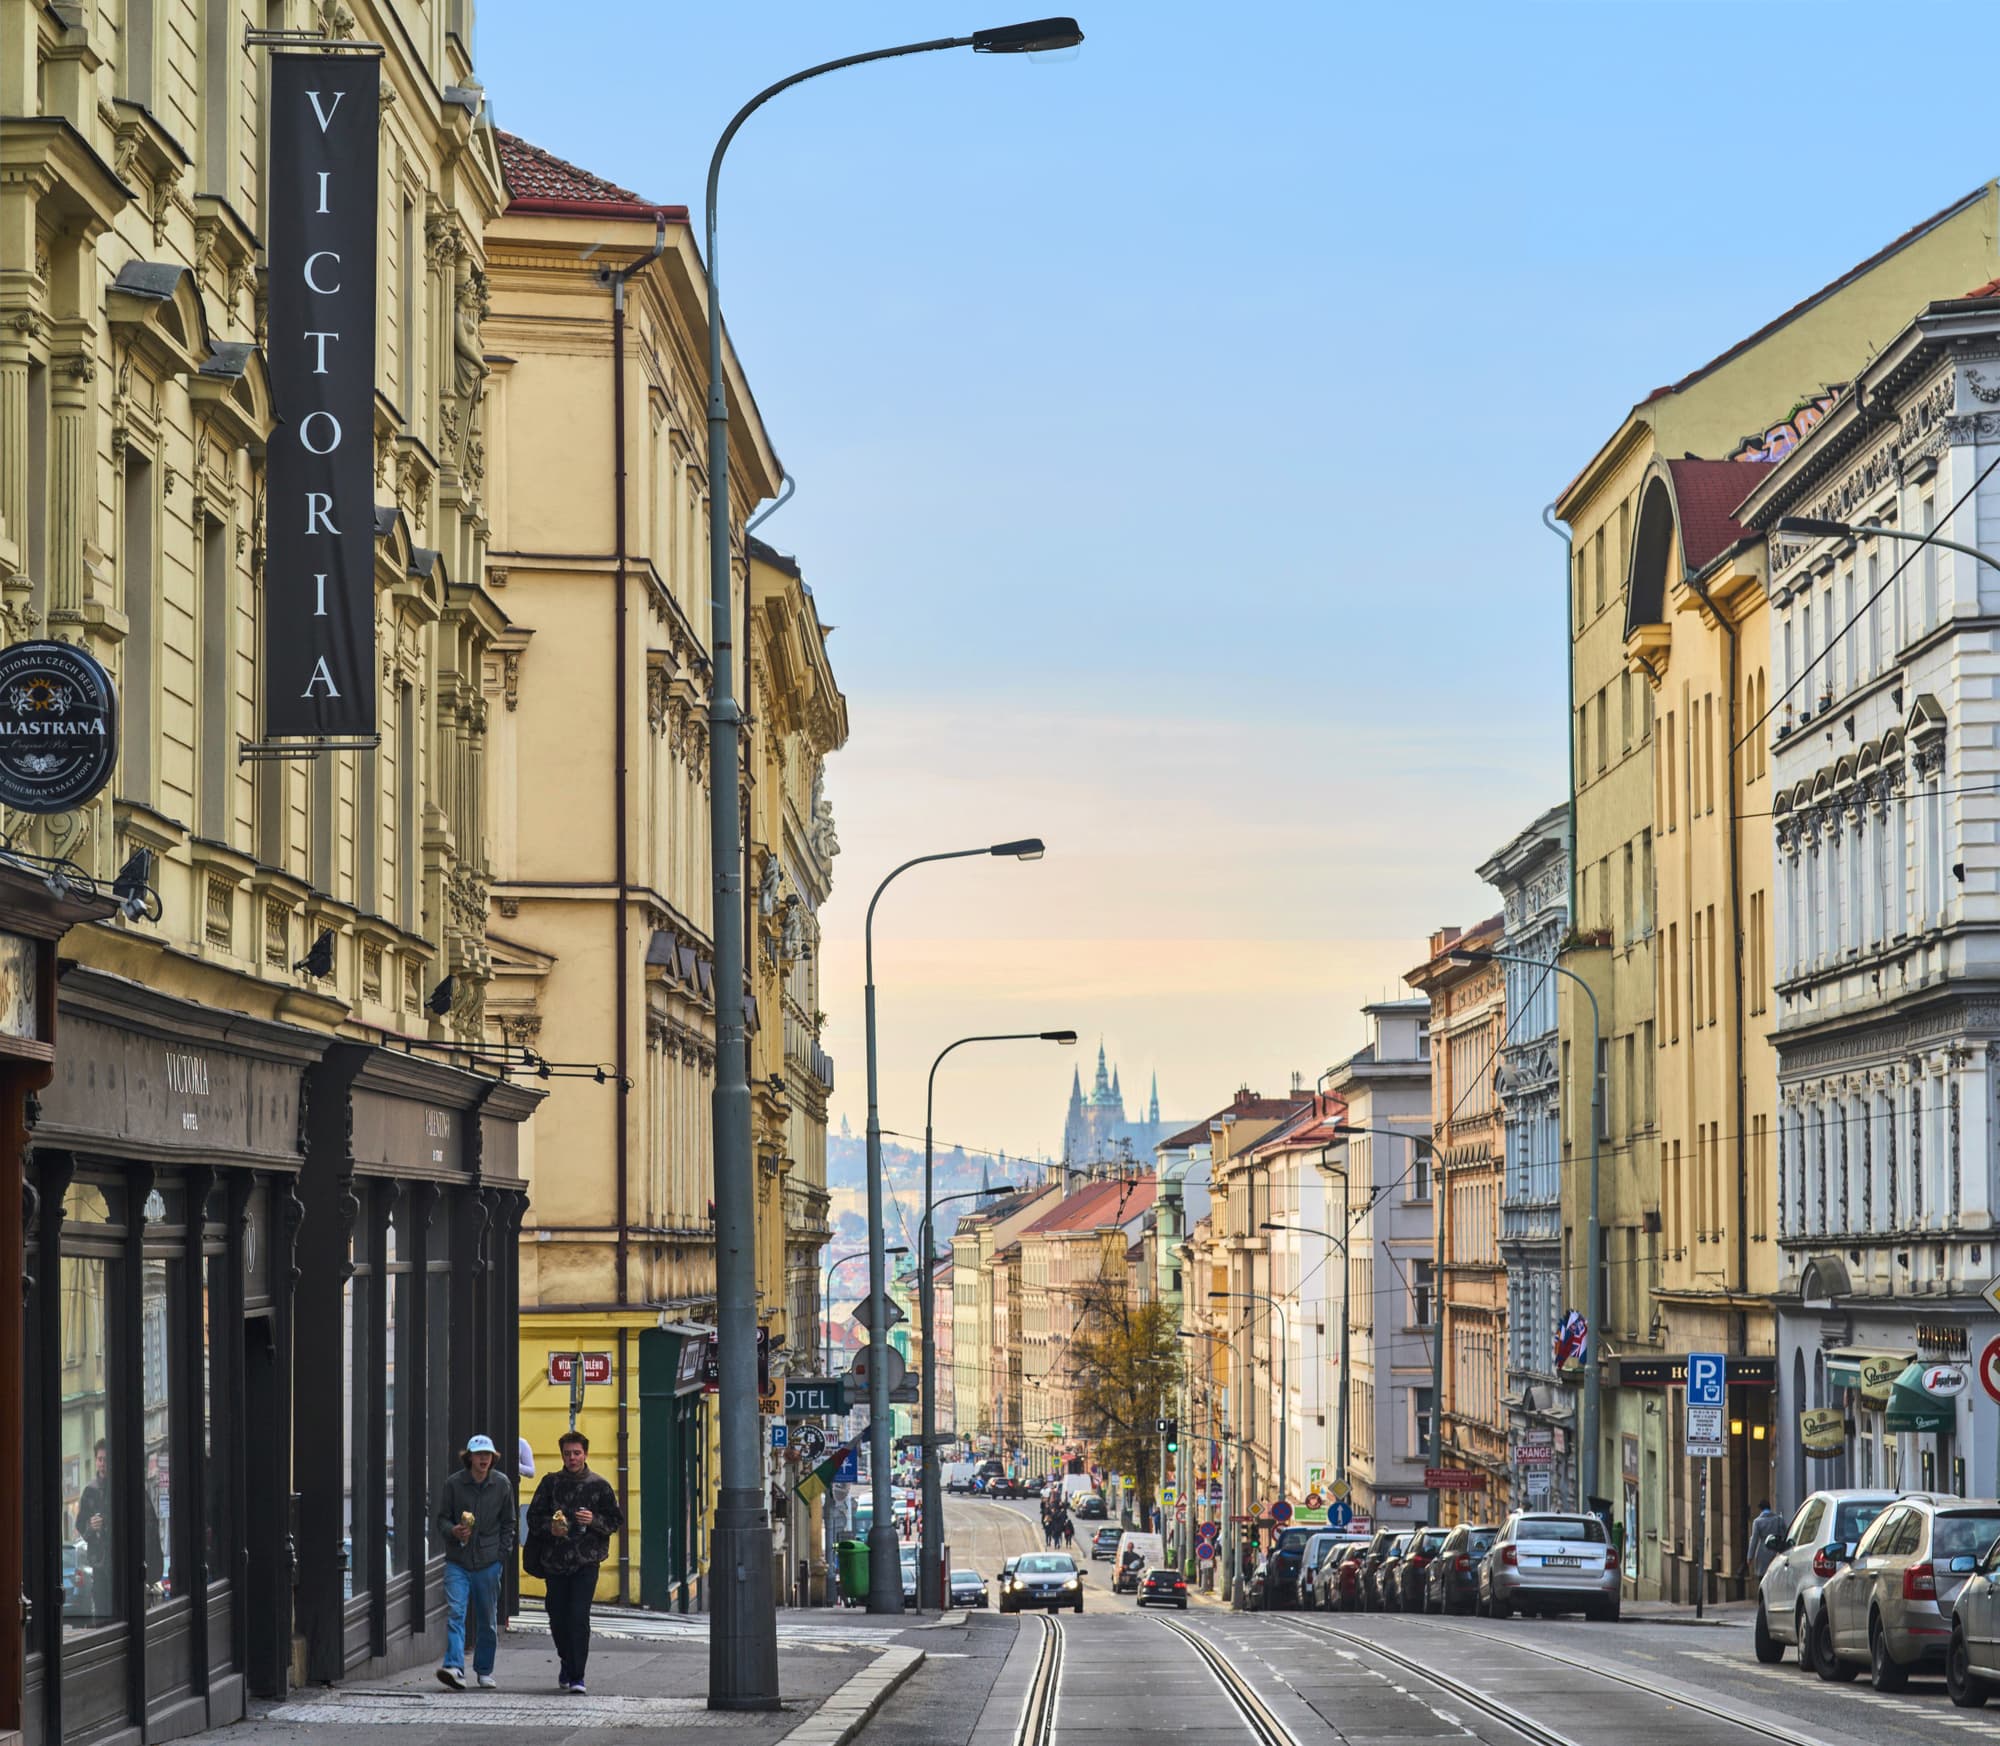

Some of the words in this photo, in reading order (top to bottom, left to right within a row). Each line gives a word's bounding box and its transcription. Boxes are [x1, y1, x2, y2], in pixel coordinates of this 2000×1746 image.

[300, 91, 346, 698] VICTORIA
[45, 656, 79, 676] CZECH
[79, 671, 97, 699] BEER
[55, 777, 76, 792] SAAZ
[75, 761, 92, 780] HOPS
[166, 1052, 209, 1095] VICTORIA
[183, 1112, 199, 1131] HOTEL
[1695, 1360, 1717, 1389] P
[774, 1429, 784, 1441] P
[1517, 1447, 1551, 1458] CHANGE
